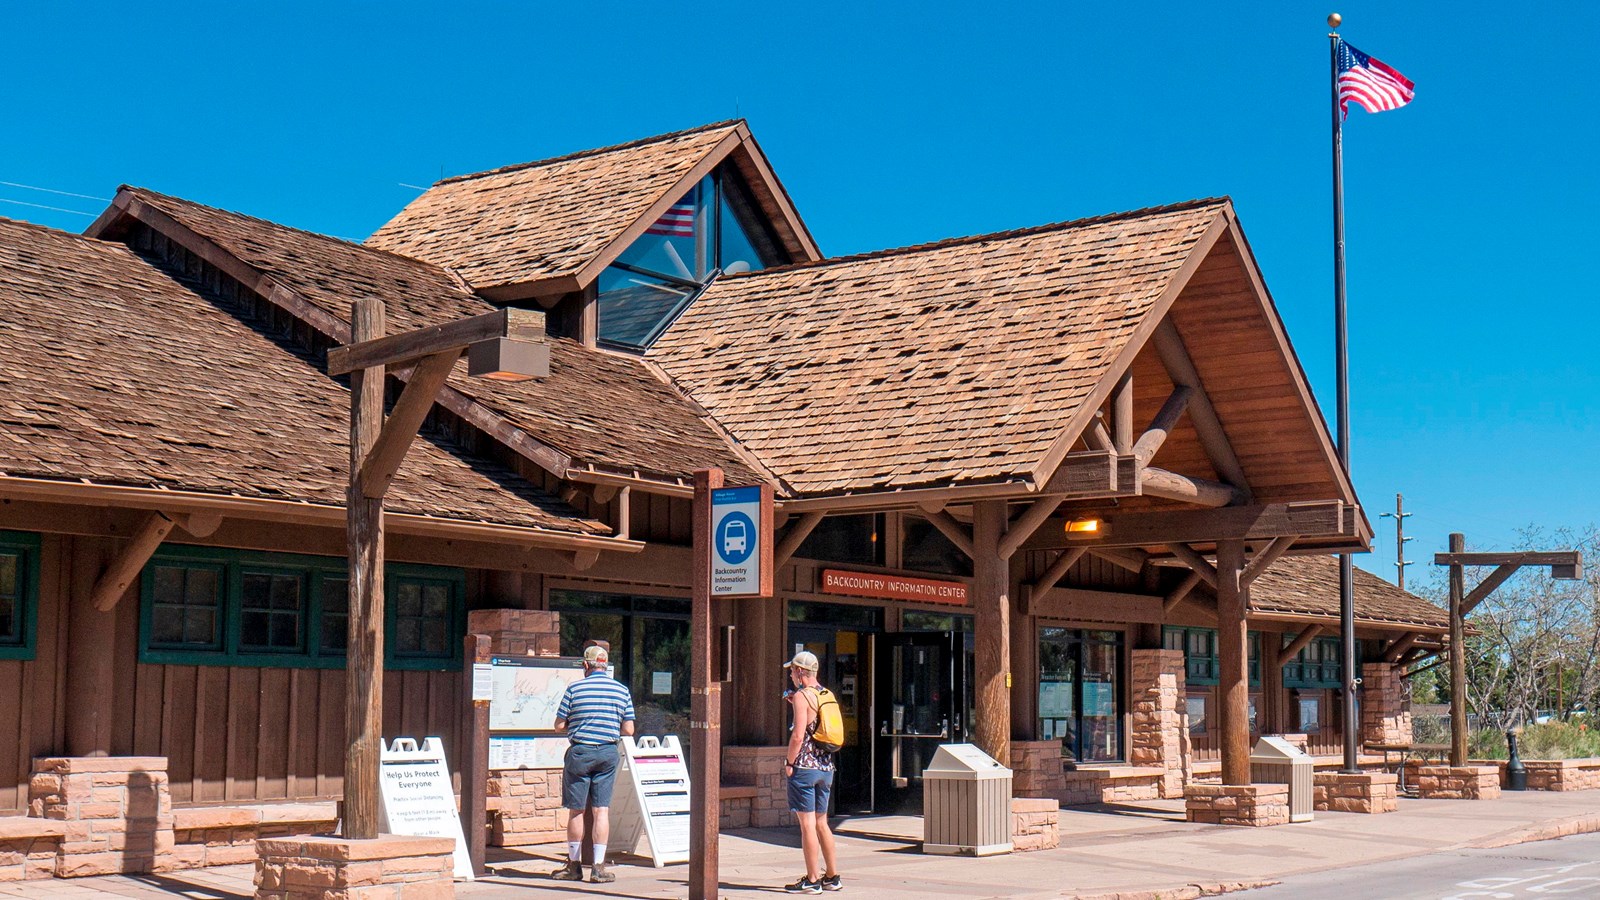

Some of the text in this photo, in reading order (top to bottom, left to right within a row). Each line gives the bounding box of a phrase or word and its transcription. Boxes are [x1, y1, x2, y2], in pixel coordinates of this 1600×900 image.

[827, 575, 966, 598] BACKCOUNTRY INFORMATION CENTER
[386, 771, 403, 780] Help
[398, 781, 432, 789] Everyone
